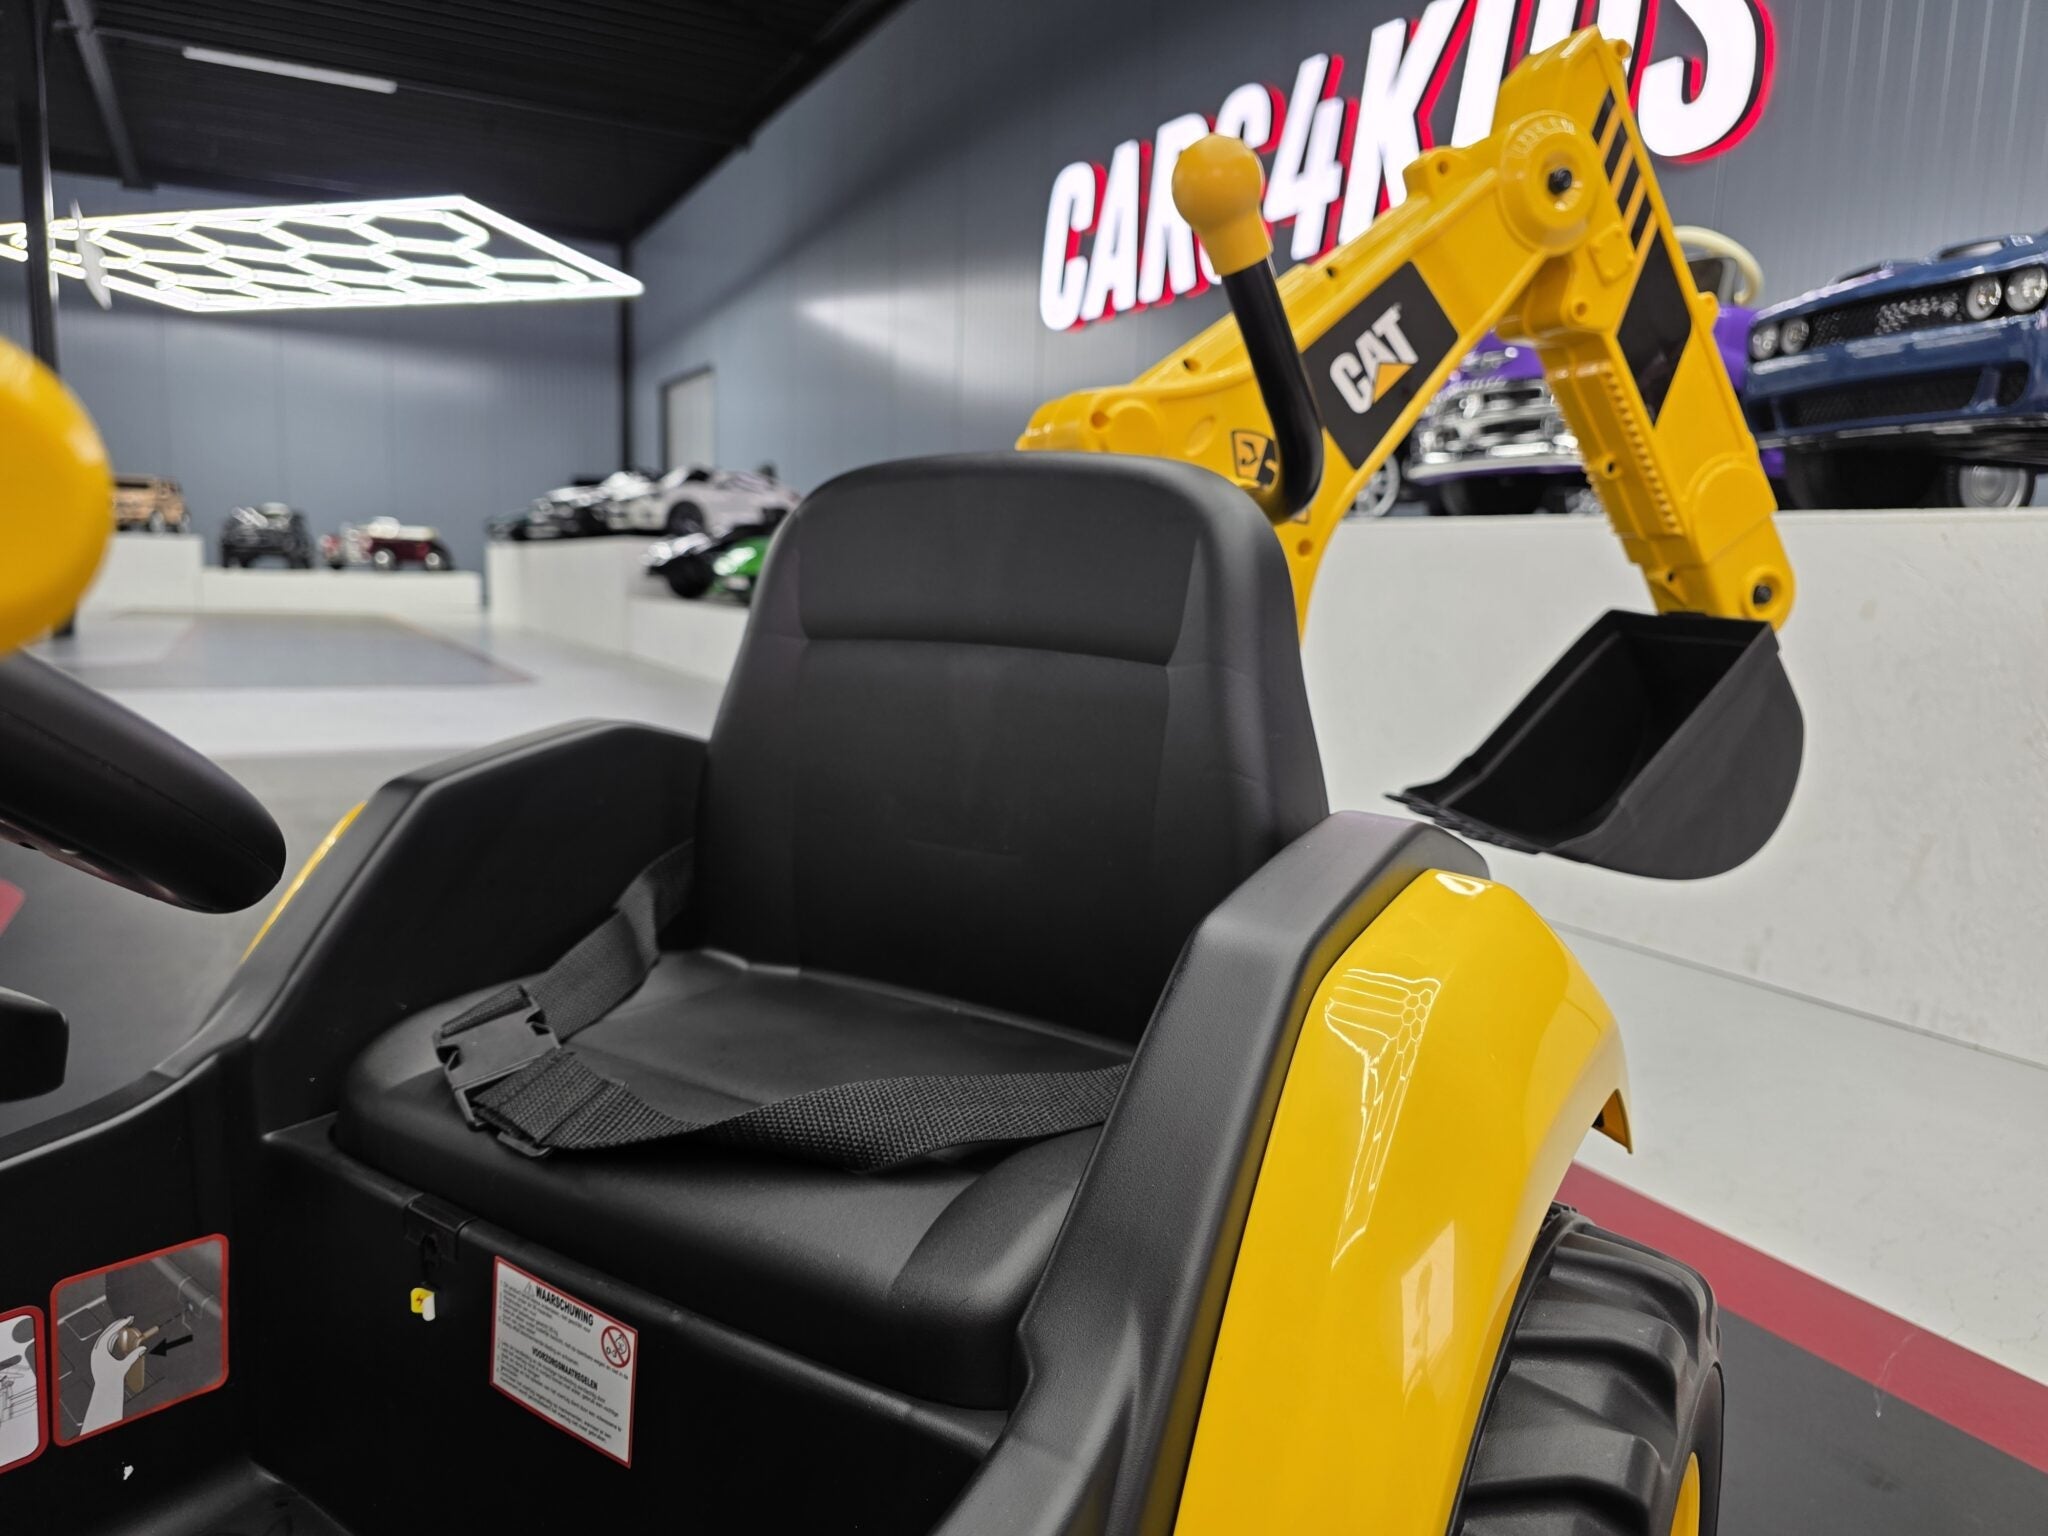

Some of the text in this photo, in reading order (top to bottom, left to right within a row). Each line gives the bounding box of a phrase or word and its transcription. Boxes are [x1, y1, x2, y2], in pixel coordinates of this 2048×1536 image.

[1040, 0, 1760, 331] CAR4KIS
[1330, 302, 1418, 414] CAT
[536, 1284, 594, 1326] WAARSCHUWING
